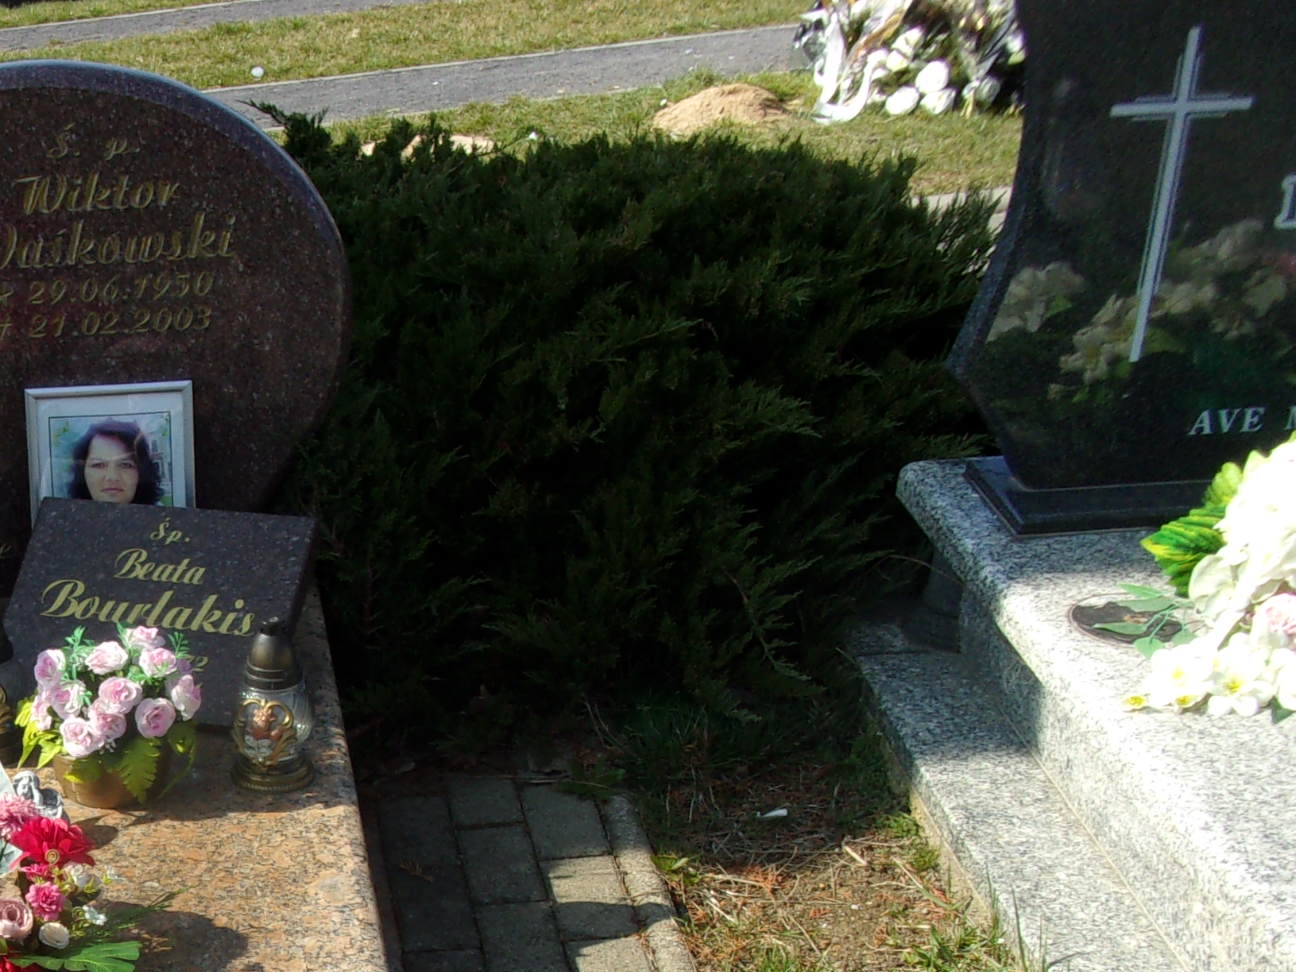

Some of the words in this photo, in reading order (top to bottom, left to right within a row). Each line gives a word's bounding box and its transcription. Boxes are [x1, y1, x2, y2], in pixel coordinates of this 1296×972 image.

[15, 171, 180, 214] Wiktor
[1188, 406, 1265, 435] AVE
[113, 548, 206, 586] Beata
[40, 578, 255, 637] Bourlakis
